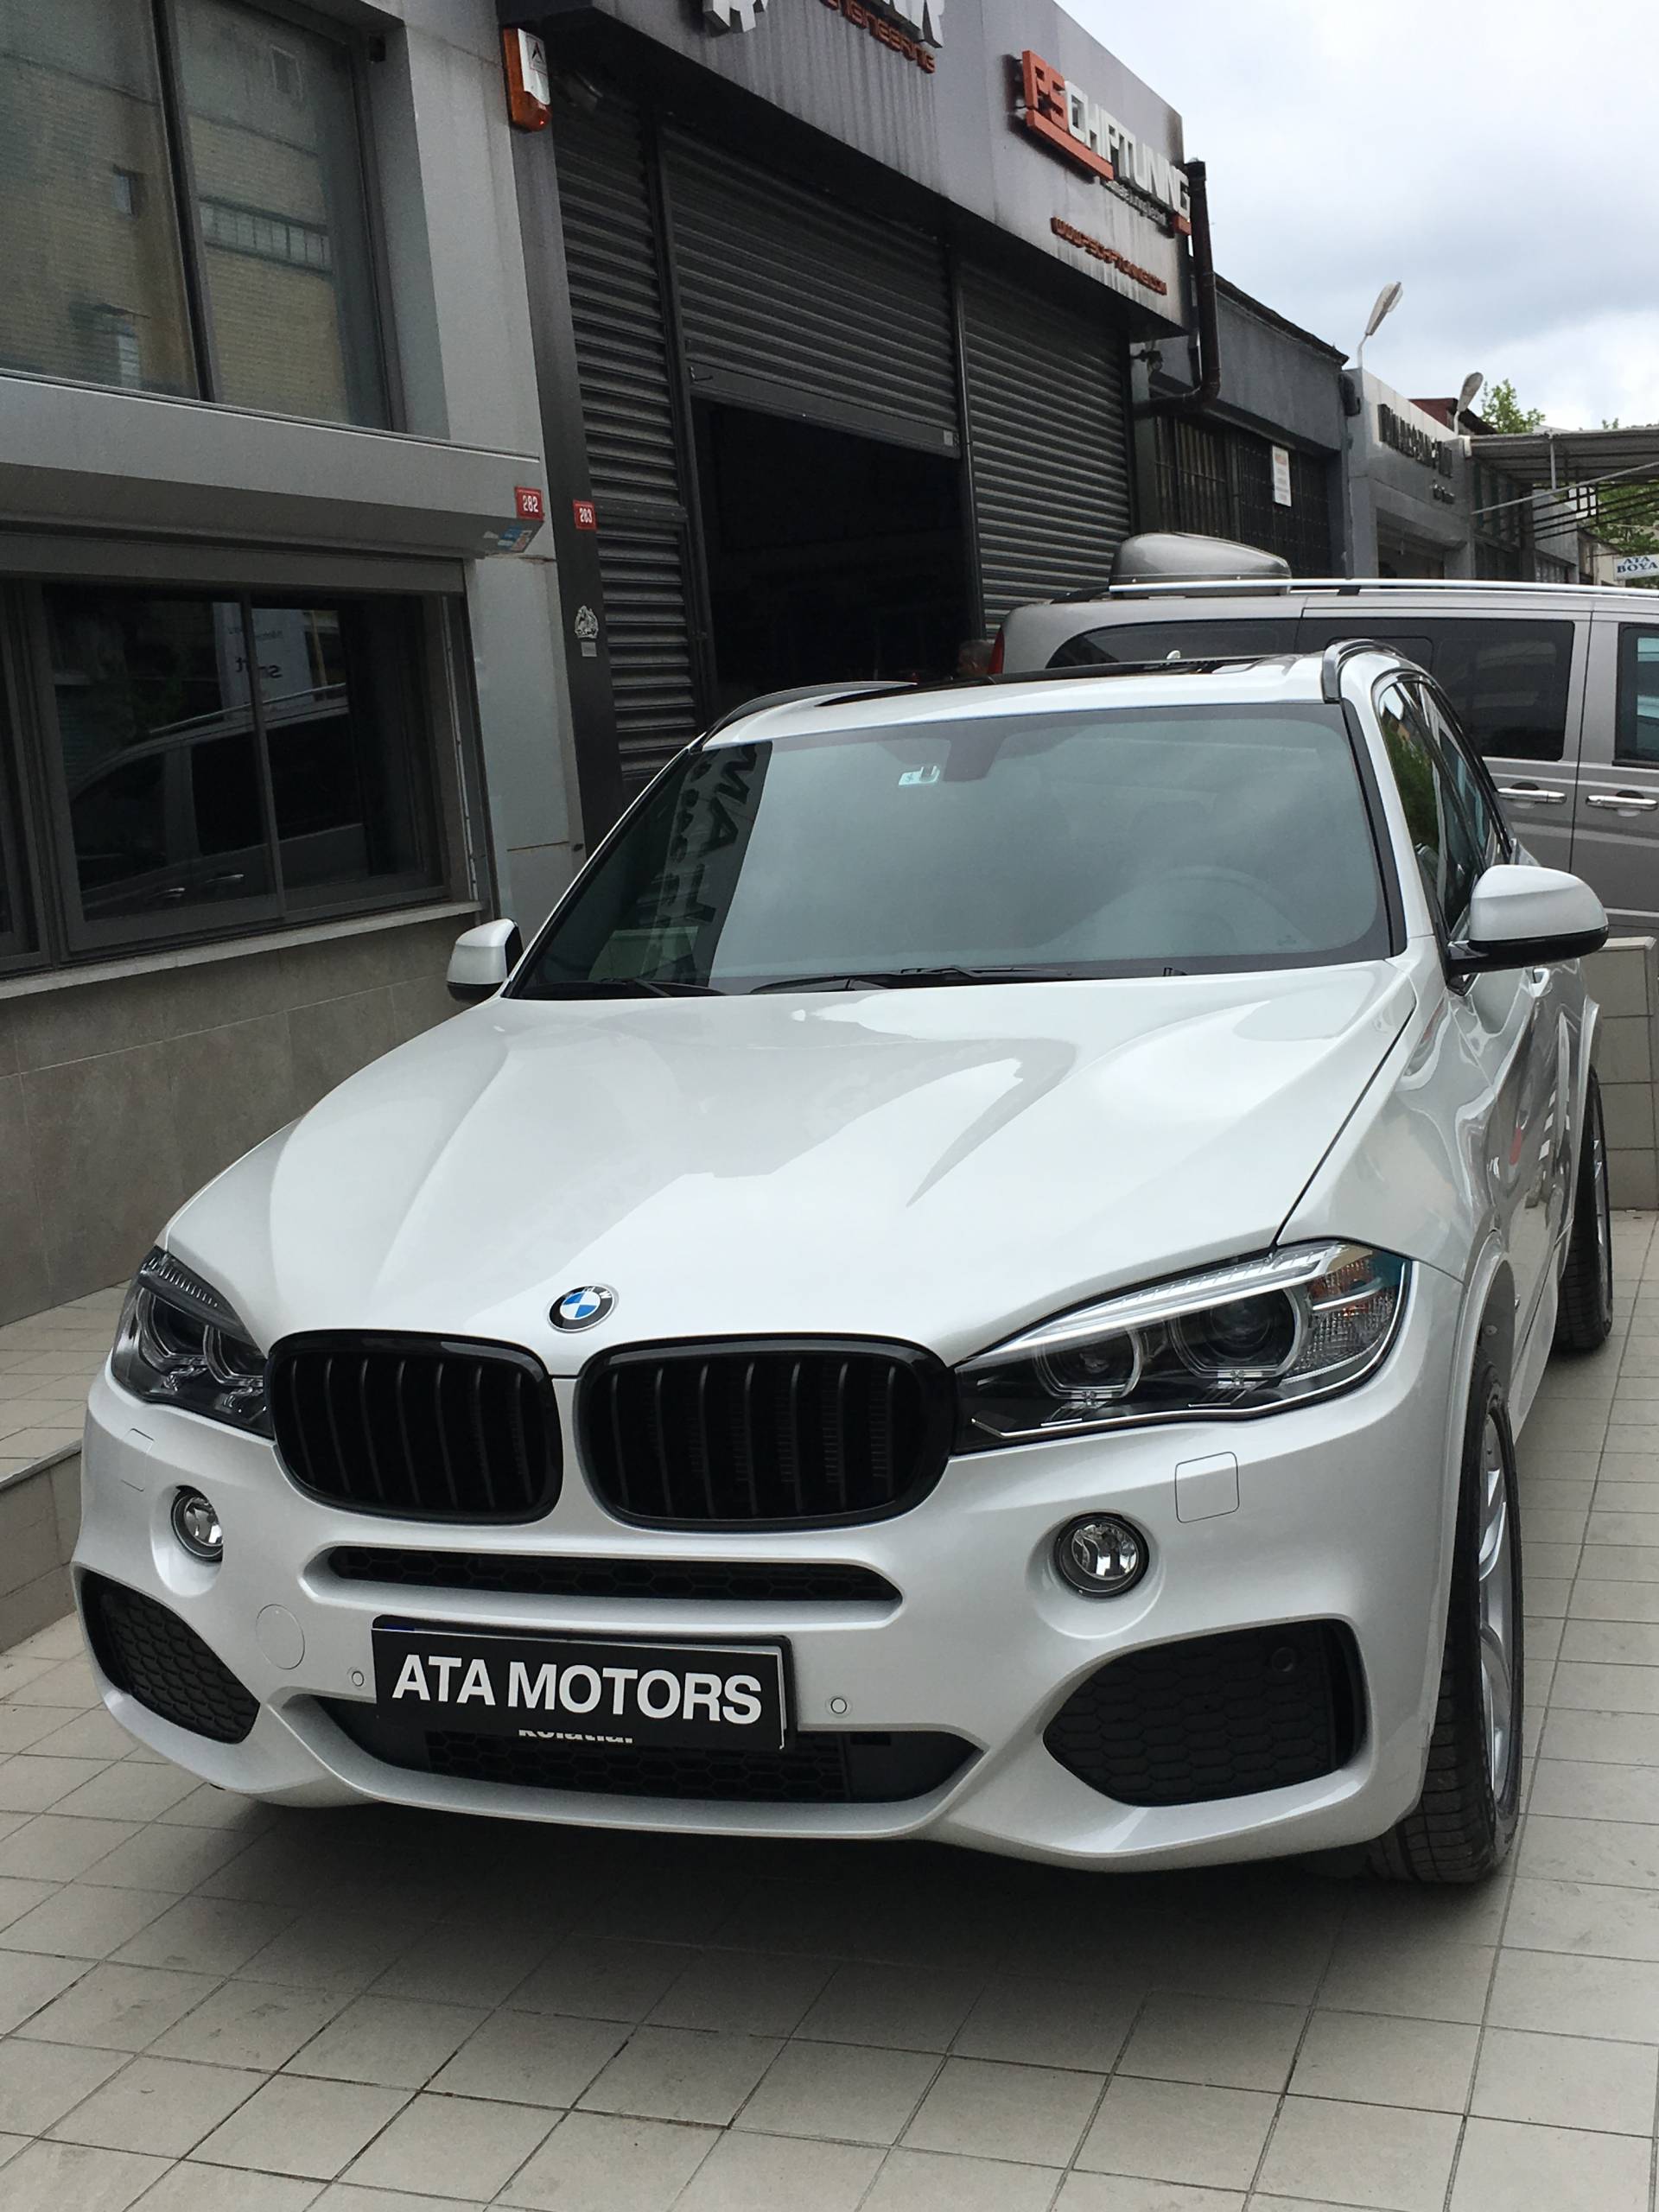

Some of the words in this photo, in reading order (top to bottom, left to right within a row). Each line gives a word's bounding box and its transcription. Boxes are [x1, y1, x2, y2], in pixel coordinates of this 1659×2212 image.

[522, 495, 539, 513] 282
[1617, 562, 1658, 574] BOYA
[391, 1654, 496, 1706] ATA
[507, 1661, 762, 1725] MOTORS
